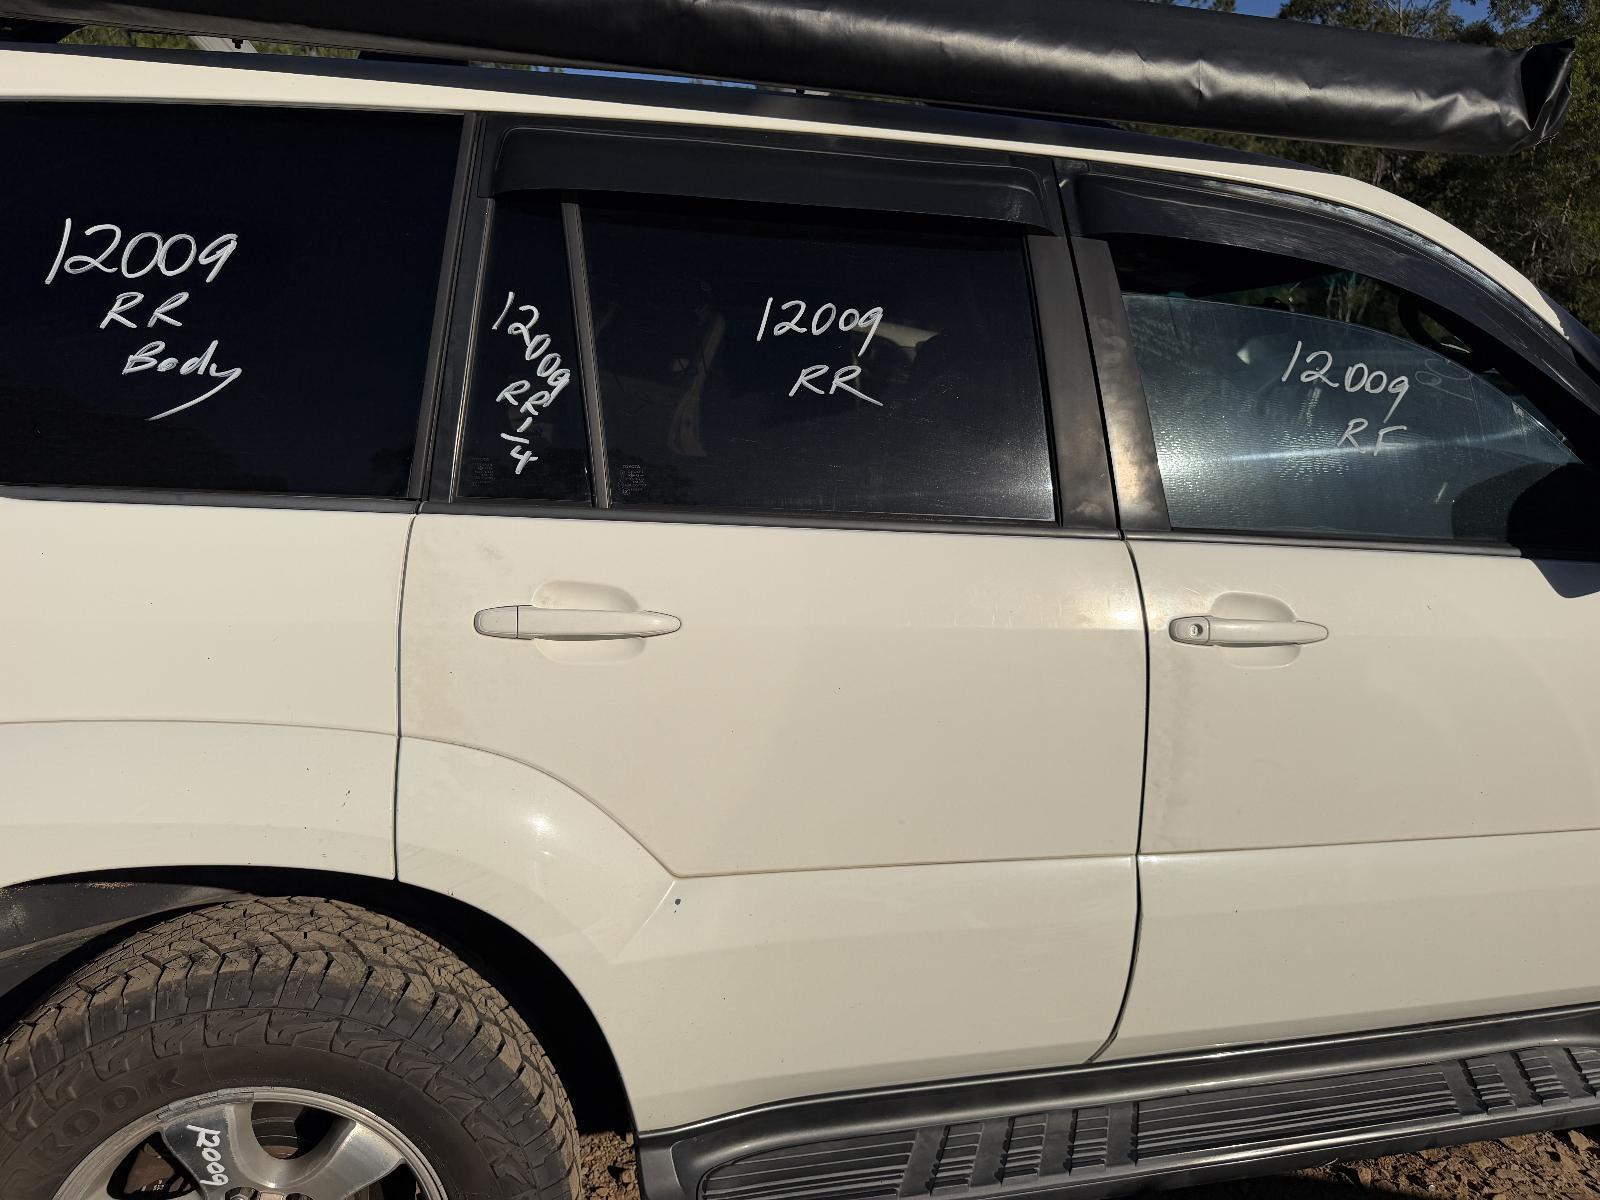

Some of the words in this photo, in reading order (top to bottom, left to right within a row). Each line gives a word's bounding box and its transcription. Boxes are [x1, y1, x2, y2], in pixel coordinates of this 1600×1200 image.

[45, 217, 238, 285] 12009
[491, 291, 570, 408] 12009
[756, 297, 883, 357] 12009
[121, 339, 242, 421] Body
[789, 364, 884, 406] RR
[1281, 340, 1409, 423] 12009
[1336, 418, 1408, 456] RF
[186, 1124, 229, 1186] 12009
